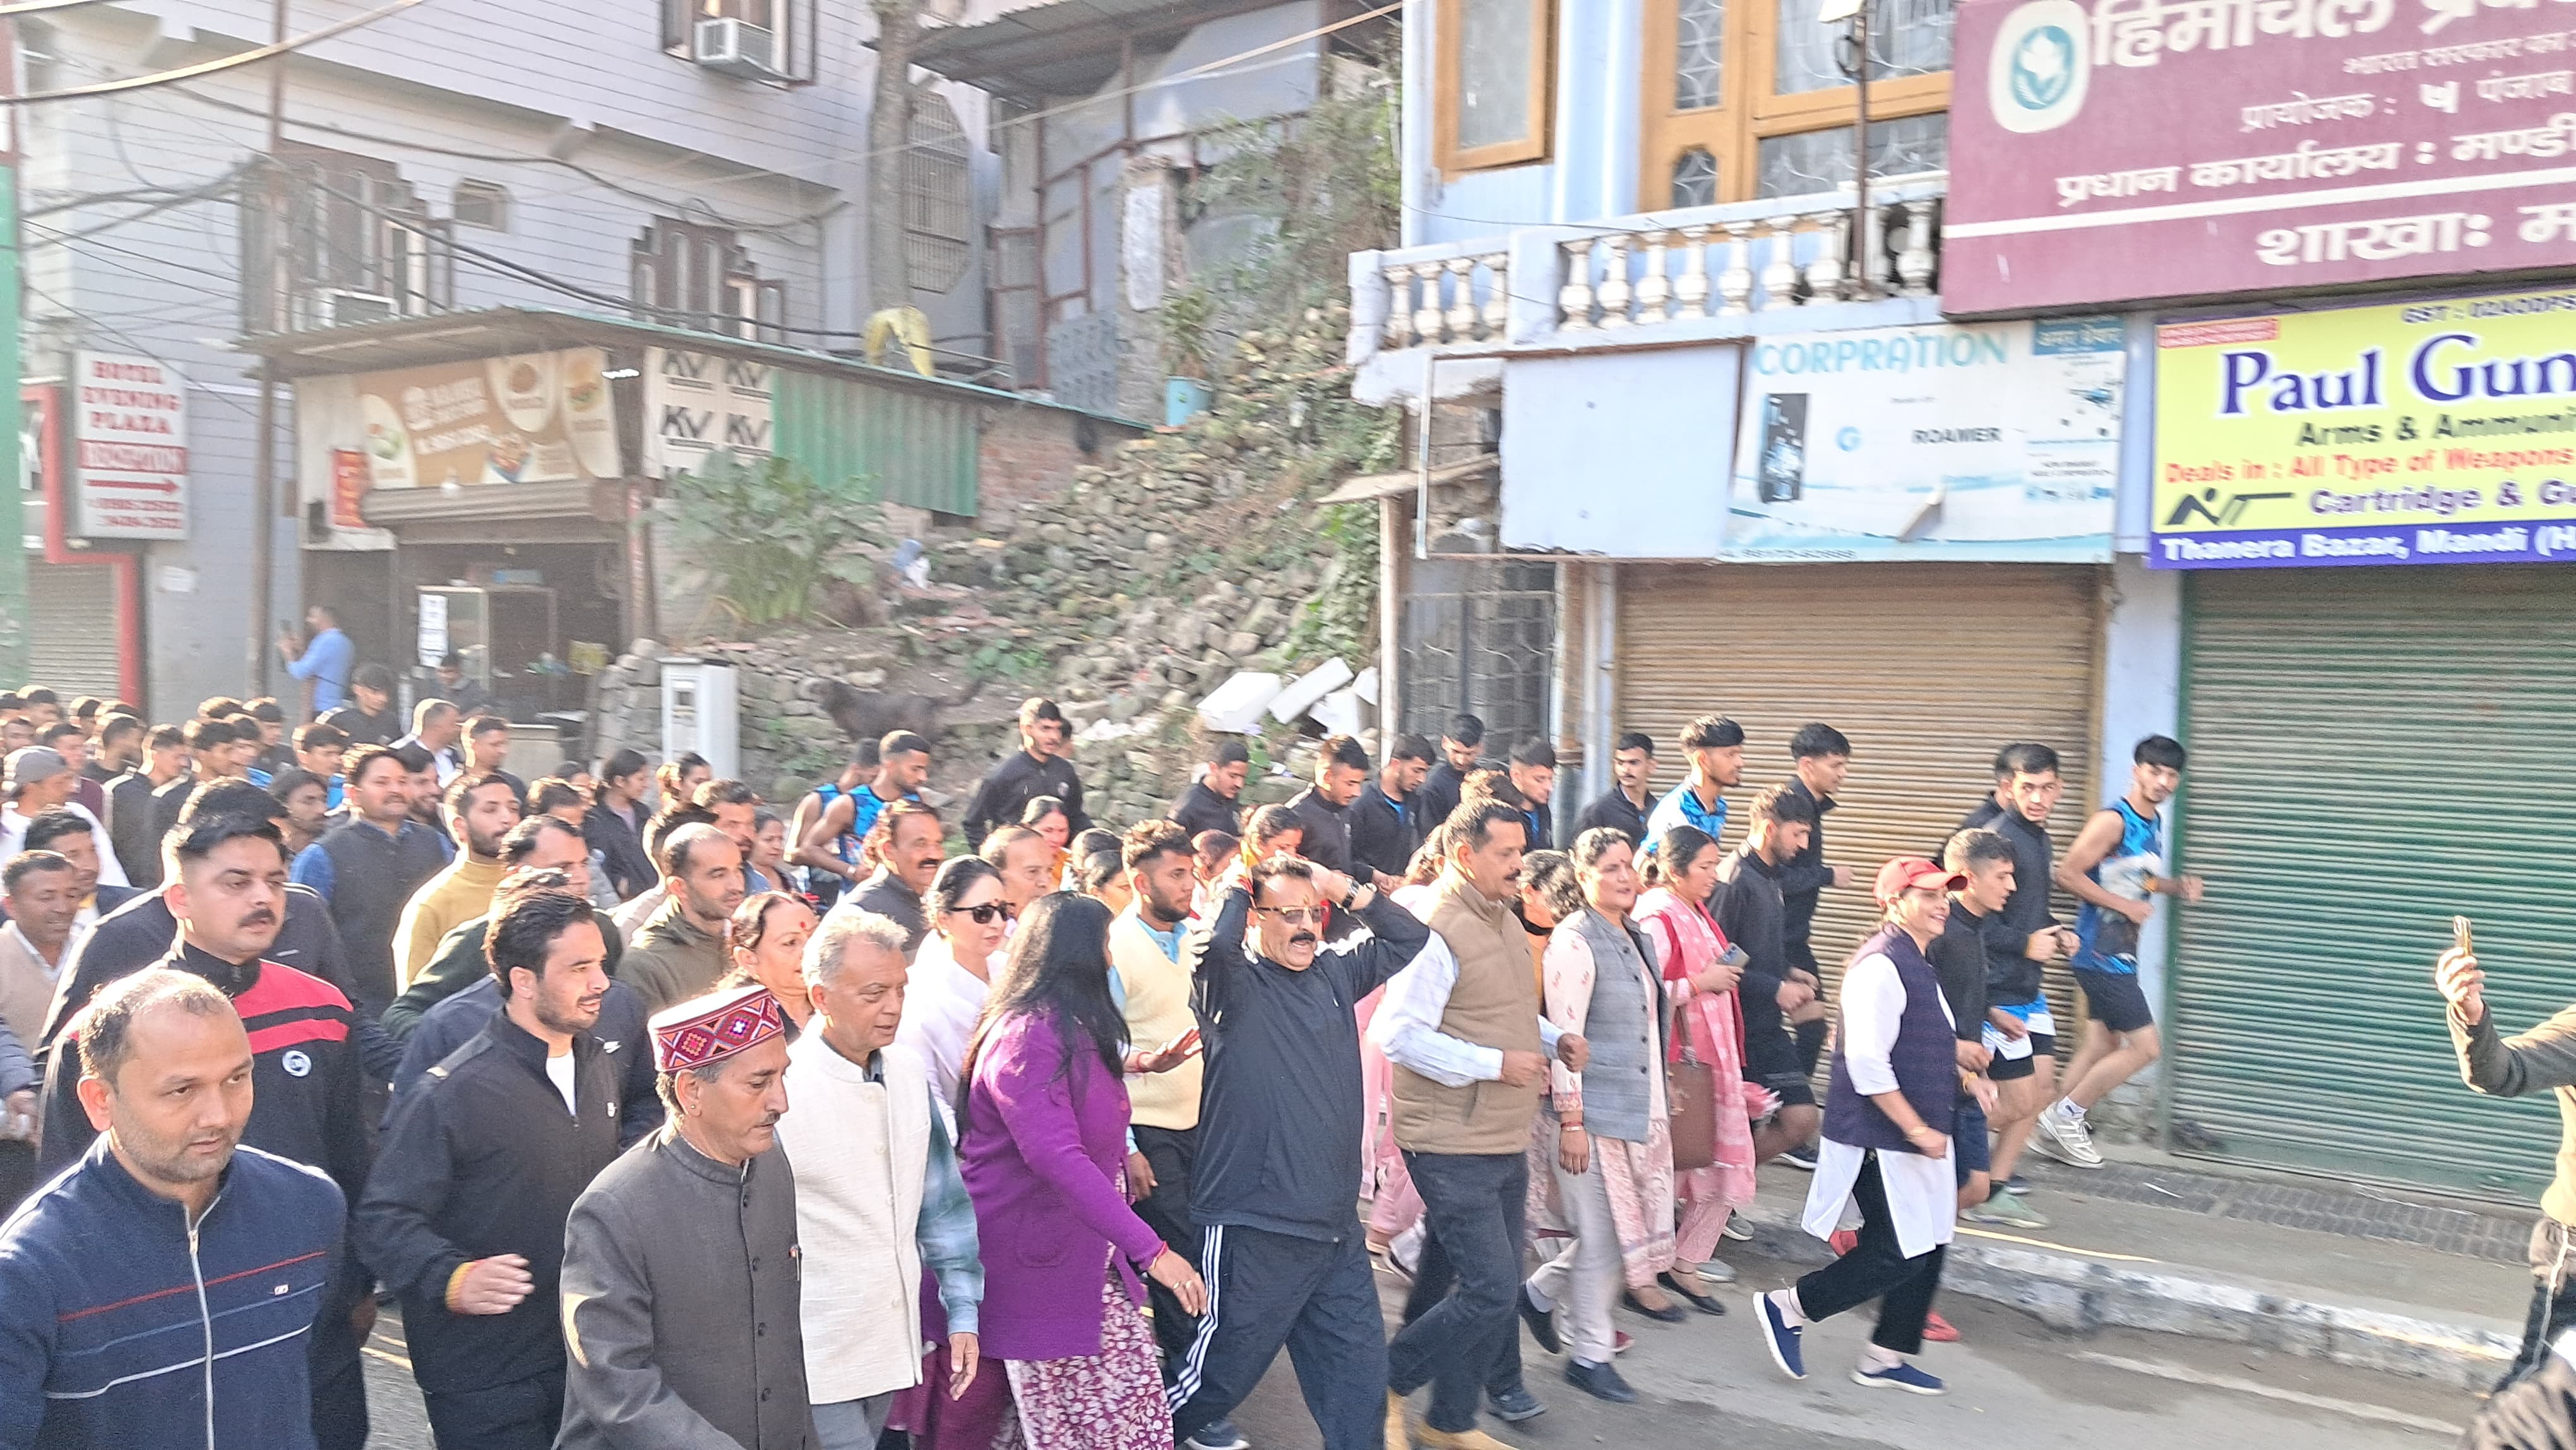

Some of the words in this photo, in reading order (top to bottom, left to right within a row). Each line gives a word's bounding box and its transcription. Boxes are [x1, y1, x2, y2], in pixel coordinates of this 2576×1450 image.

[2054, 165, 2184, 208] प्रधान
[2188, 139, 2406, 188] कार्यालय
[1755, 332, 2008, 375] CORPRATION
[2221, 348, 2383, 414] Paul
[2412, 333, 2576, 401] Gun
[90, 410, 174, 434] PLAZA
[1912, 427, 2002, 444] ROAMER
[2296, 422, 2382, 446] Arms
[2395, 416, 2418, 441] &
[2165, 460, 2234, 482] Deals
[2289, 455, 2325, 477] All
[2333, 454, 2399, 480] Type
[2407, 449, 2436, 472] of
[2443, 447, 2575, 472] Weapons
[2310, 485, 2483, 515] Cartridge
[2495, 481, 2524, 506] &
[2159, 538, 2296, 560] Thanera
[2417, 527, 2529, 553] Mandi
